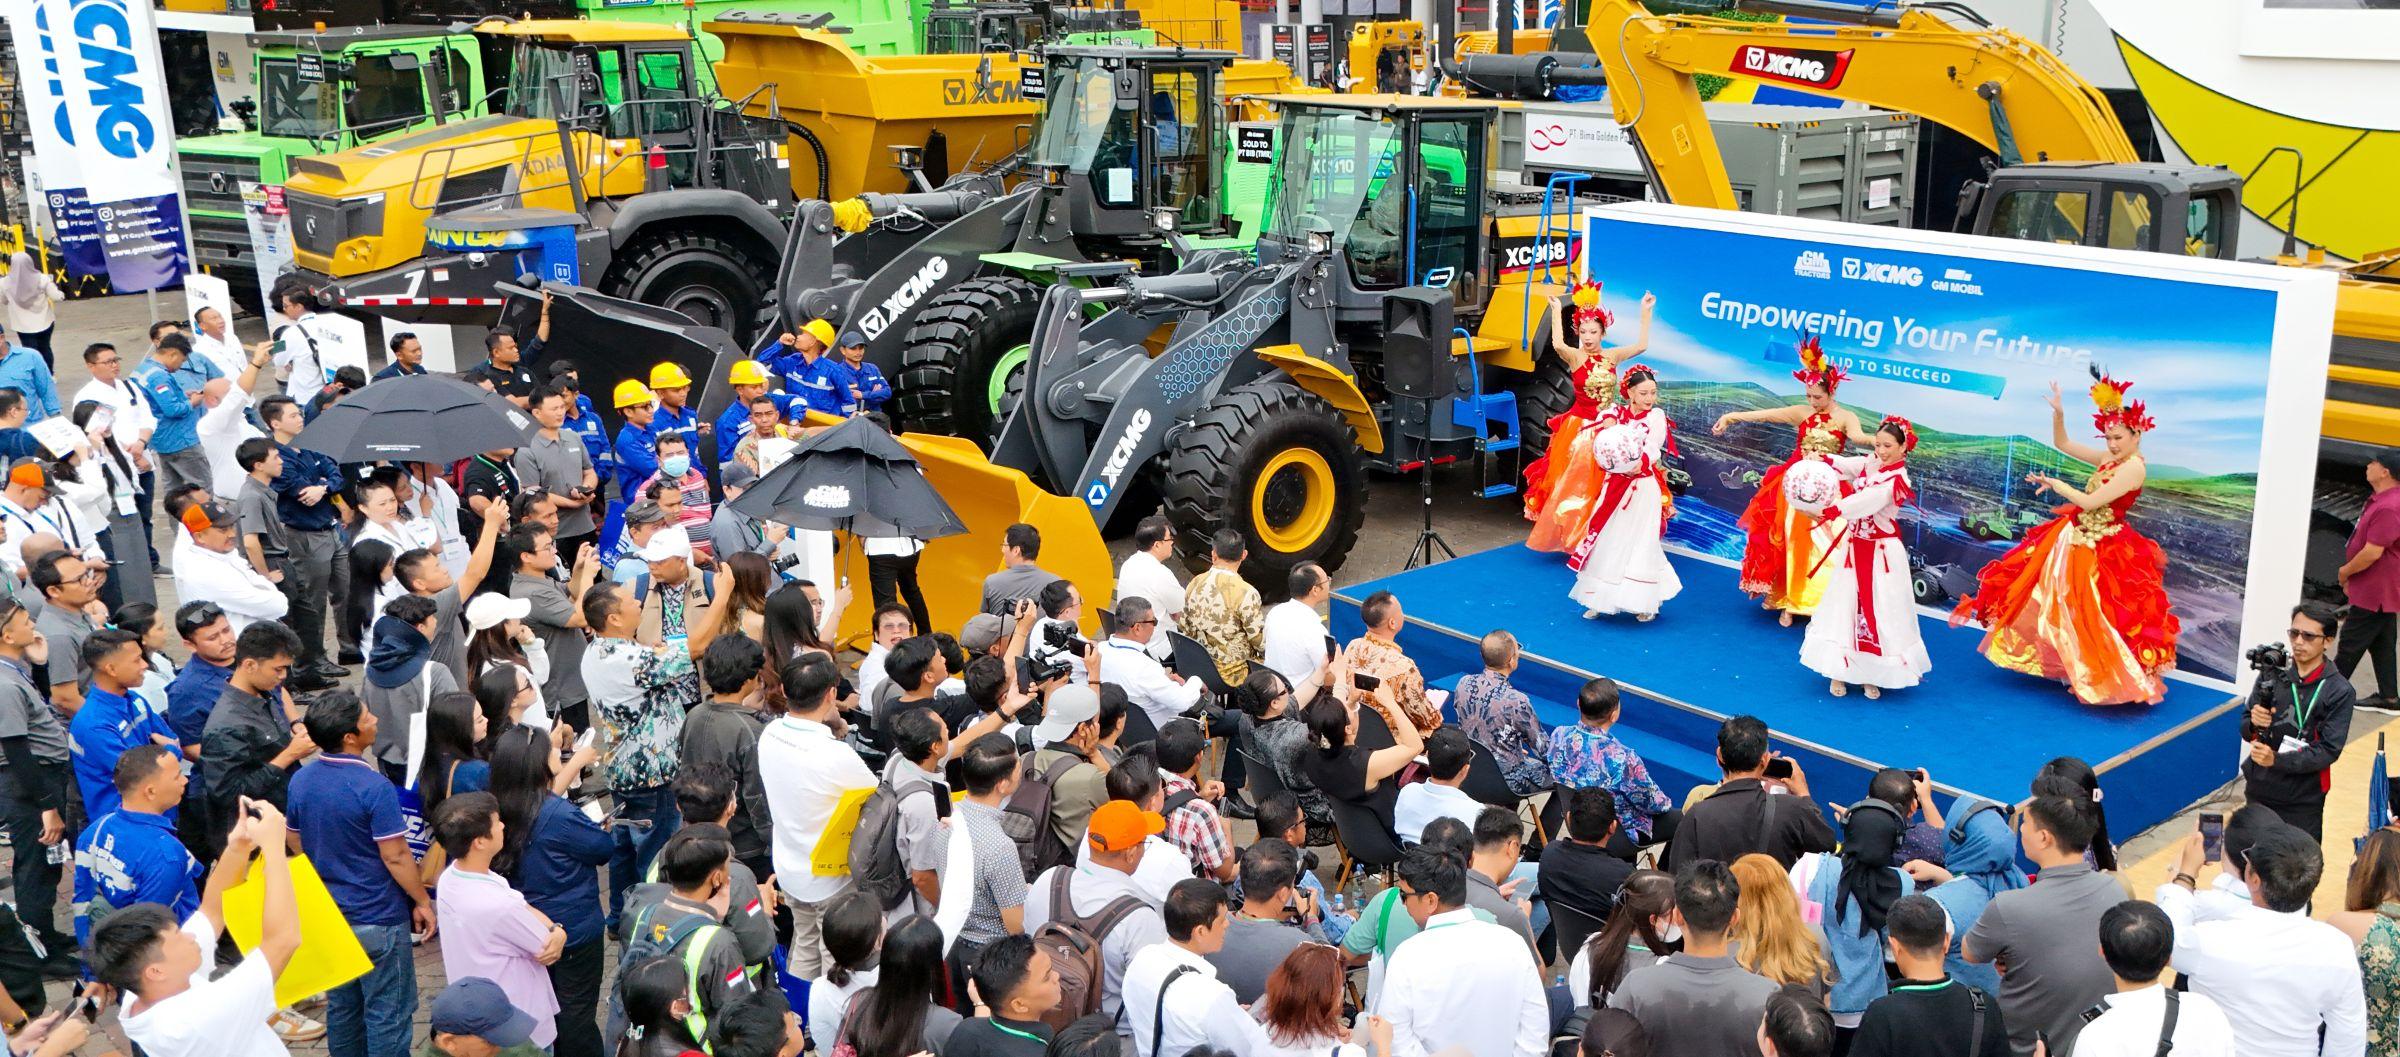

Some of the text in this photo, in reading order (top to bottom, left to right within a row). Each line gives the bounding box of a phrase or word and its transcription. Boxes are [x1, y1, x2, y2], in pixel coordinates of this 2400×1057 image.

[69, 0, 155, 159] CMG
[1763, 53, 1825, 81] XCMG
[968, 80, 1037, 104] XCM
[1243, 140, 1268, 149] SOLD TO
[1579, 130, 1595, 140] Bima
[1595, 130, 1619, 142] Golden
[1505, 241, 1566, 268] XC968
[1802, 250, 1825, 267] GM
[1794, 269, 1831, 280] TRACTORS
[1860, 262, 1923, 287] XCMG
[881, 256, 948, 325] XCMG
[1931, 280, 1984, 296] GM MOBIL
[1701, 292, 2092, 372] Empowering Your Future
[1859, 359, 1877, 372] TO
[1883, 363, 1951, 384] SUCCEED
[1100, 408, 1152, 490] XCMG
